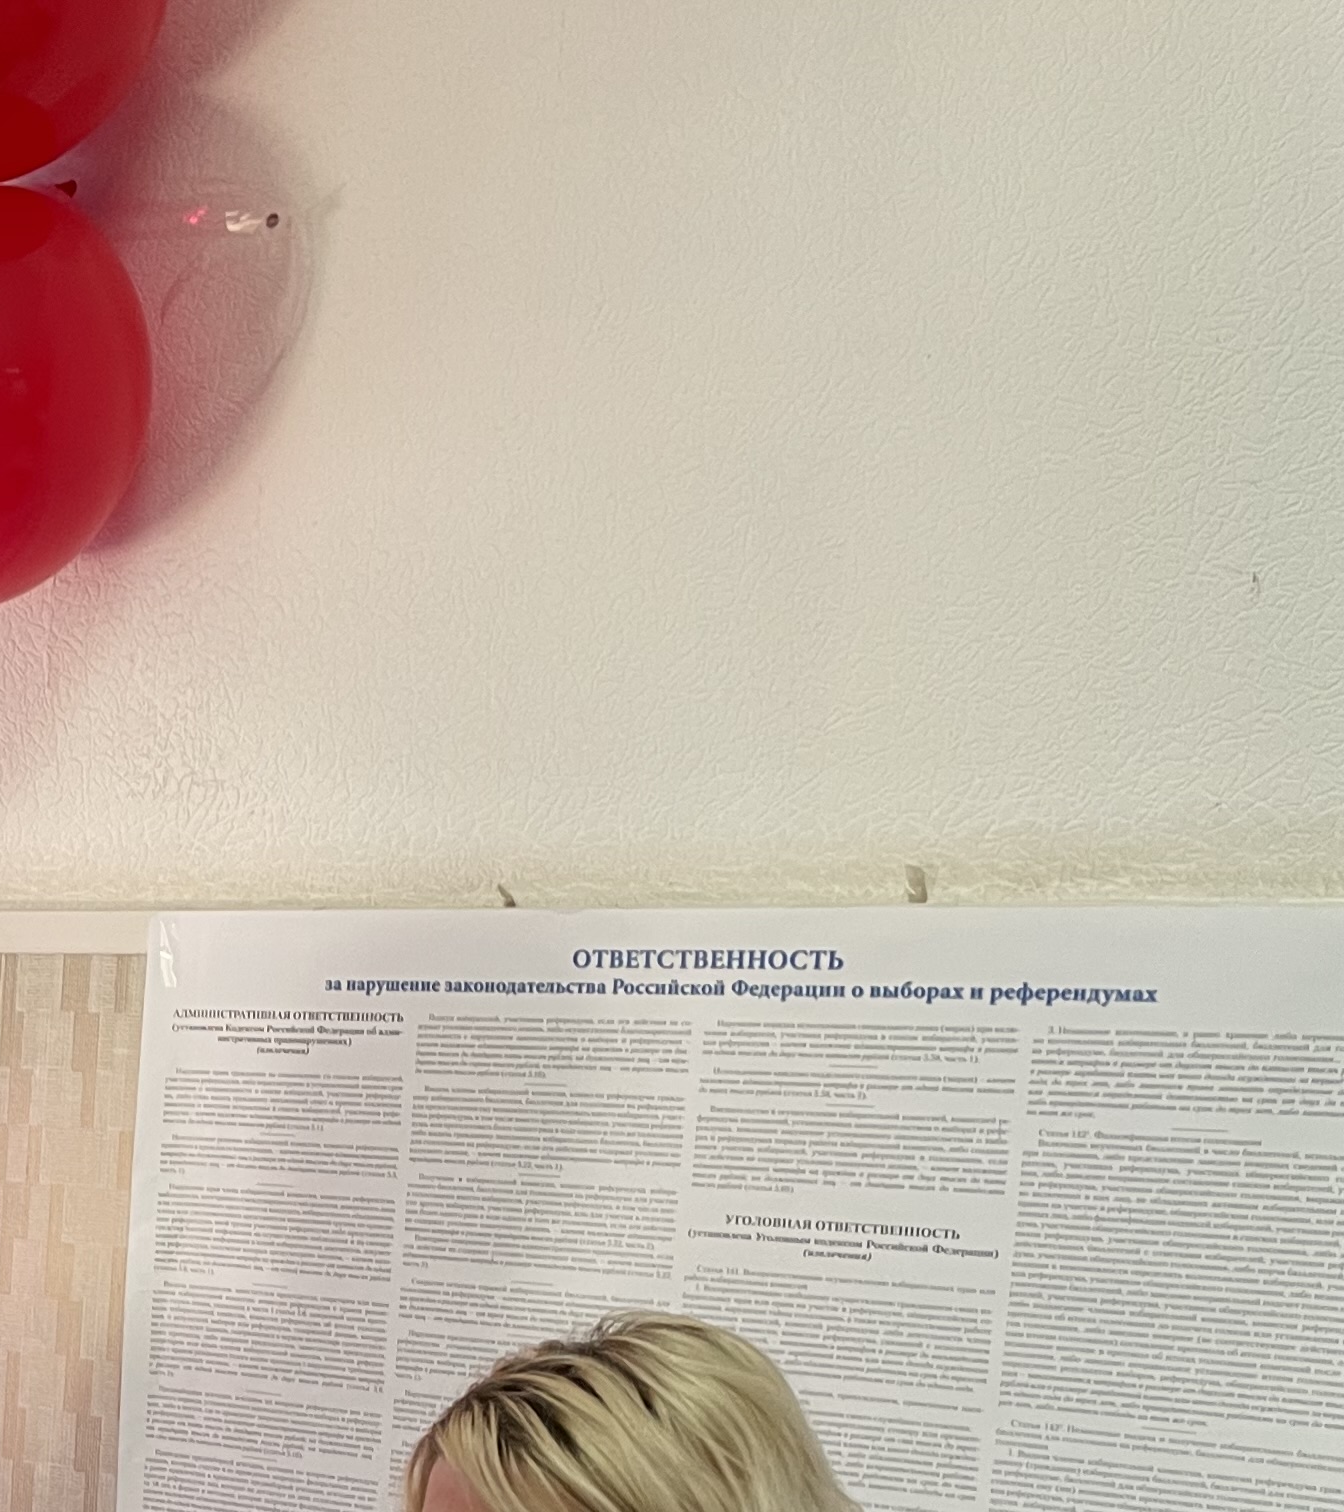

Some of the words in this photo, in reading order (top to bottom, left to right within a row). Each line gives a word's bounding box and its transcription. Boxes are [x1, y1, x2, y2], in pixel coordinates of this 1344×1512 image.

[573, 949, 845, 971] ОТВЕТСТВЕННОСТЬ
[324, 979, 343, 992] за
[346, 979, 441, 996] нарушение
[444, 979, 607, 996] законодательства
[612, 978, 725, 997] Российской
[731, 980, 846, 1001] Федерации
[851, 985, 865, 998] о
[869, 981, 964, 1004] выборах
[969, 987, 984, 1000] и
[989, 982, 1159, 1007] референдумах
